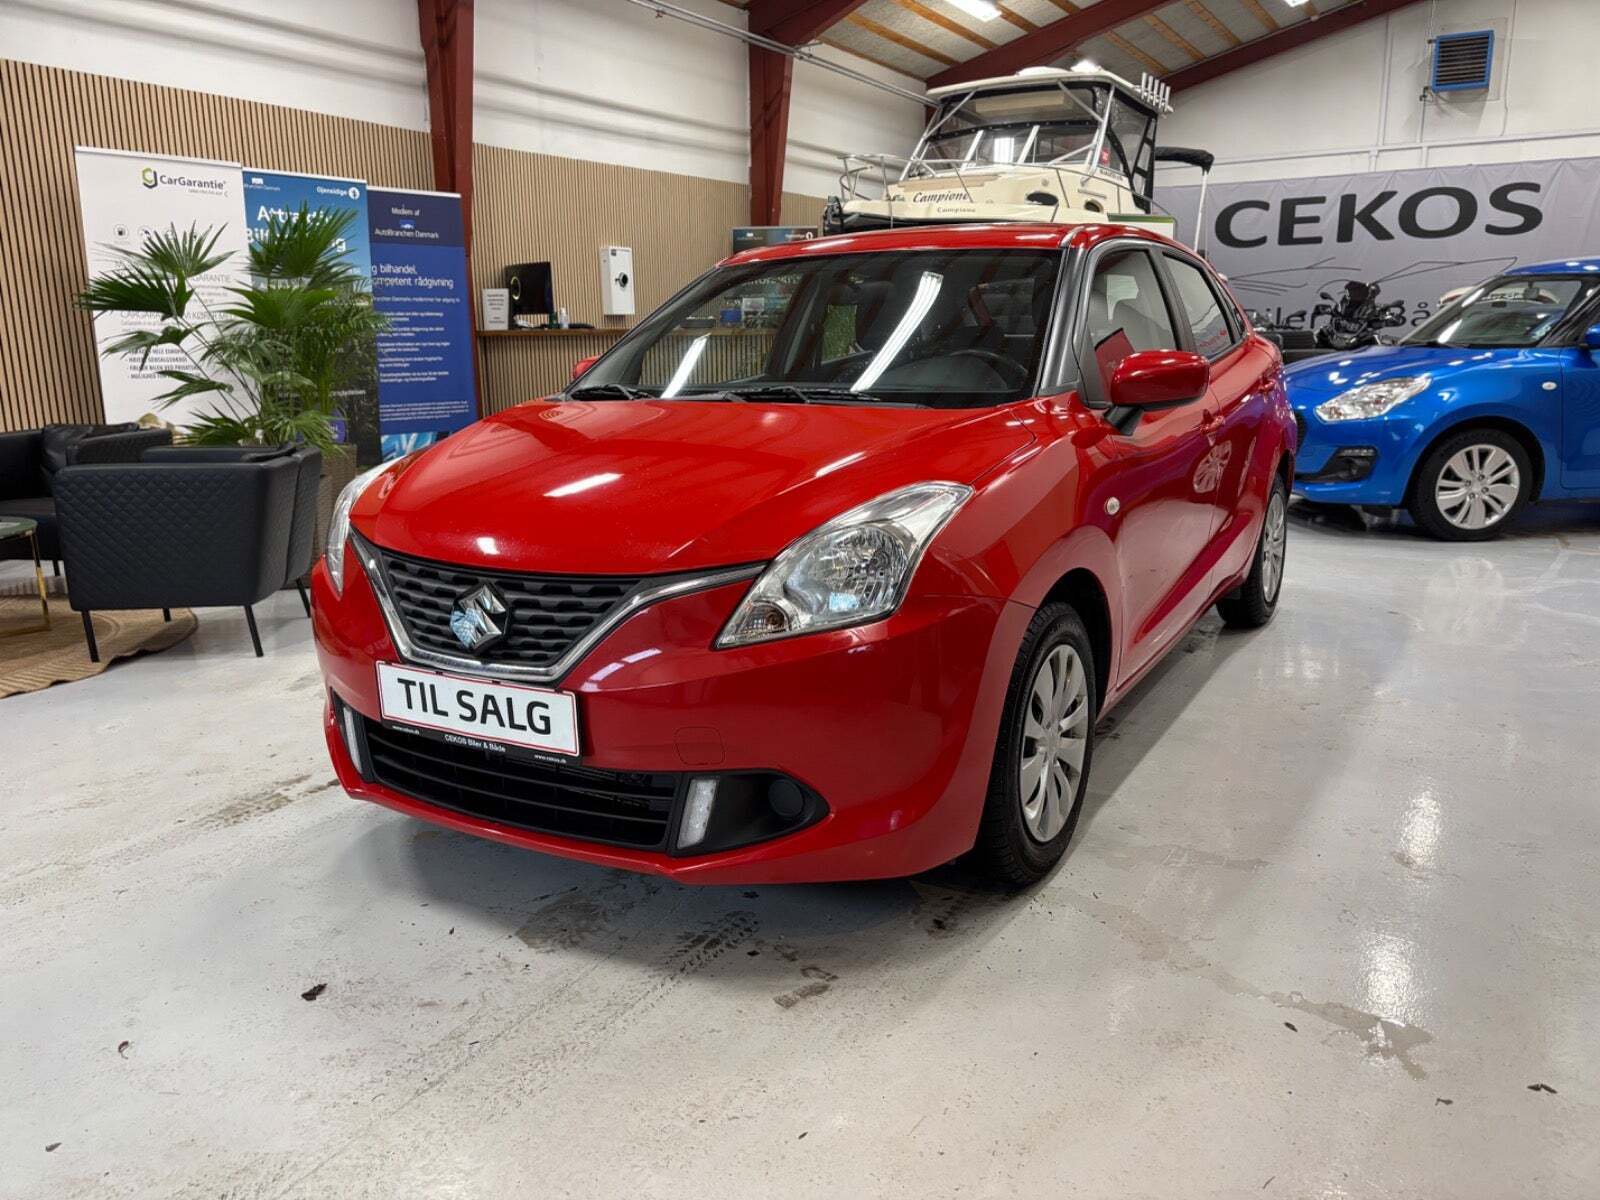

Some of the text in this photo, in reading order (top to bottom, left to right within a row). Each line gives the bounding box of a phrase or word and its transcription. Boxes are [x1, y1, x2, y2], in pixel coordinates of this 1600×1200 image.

[159, 174, 225, 190] CarGarantie
[1214, 182, 1544, 249] CEKOS
[372, 277, 412, 288] ompetent
[397, 677, 551, 736] TIL SALG
[444, 734, 467, 745] CEKOS
[467, 737, 482, 749] Biler
[489, 742, 506, 753] Både
